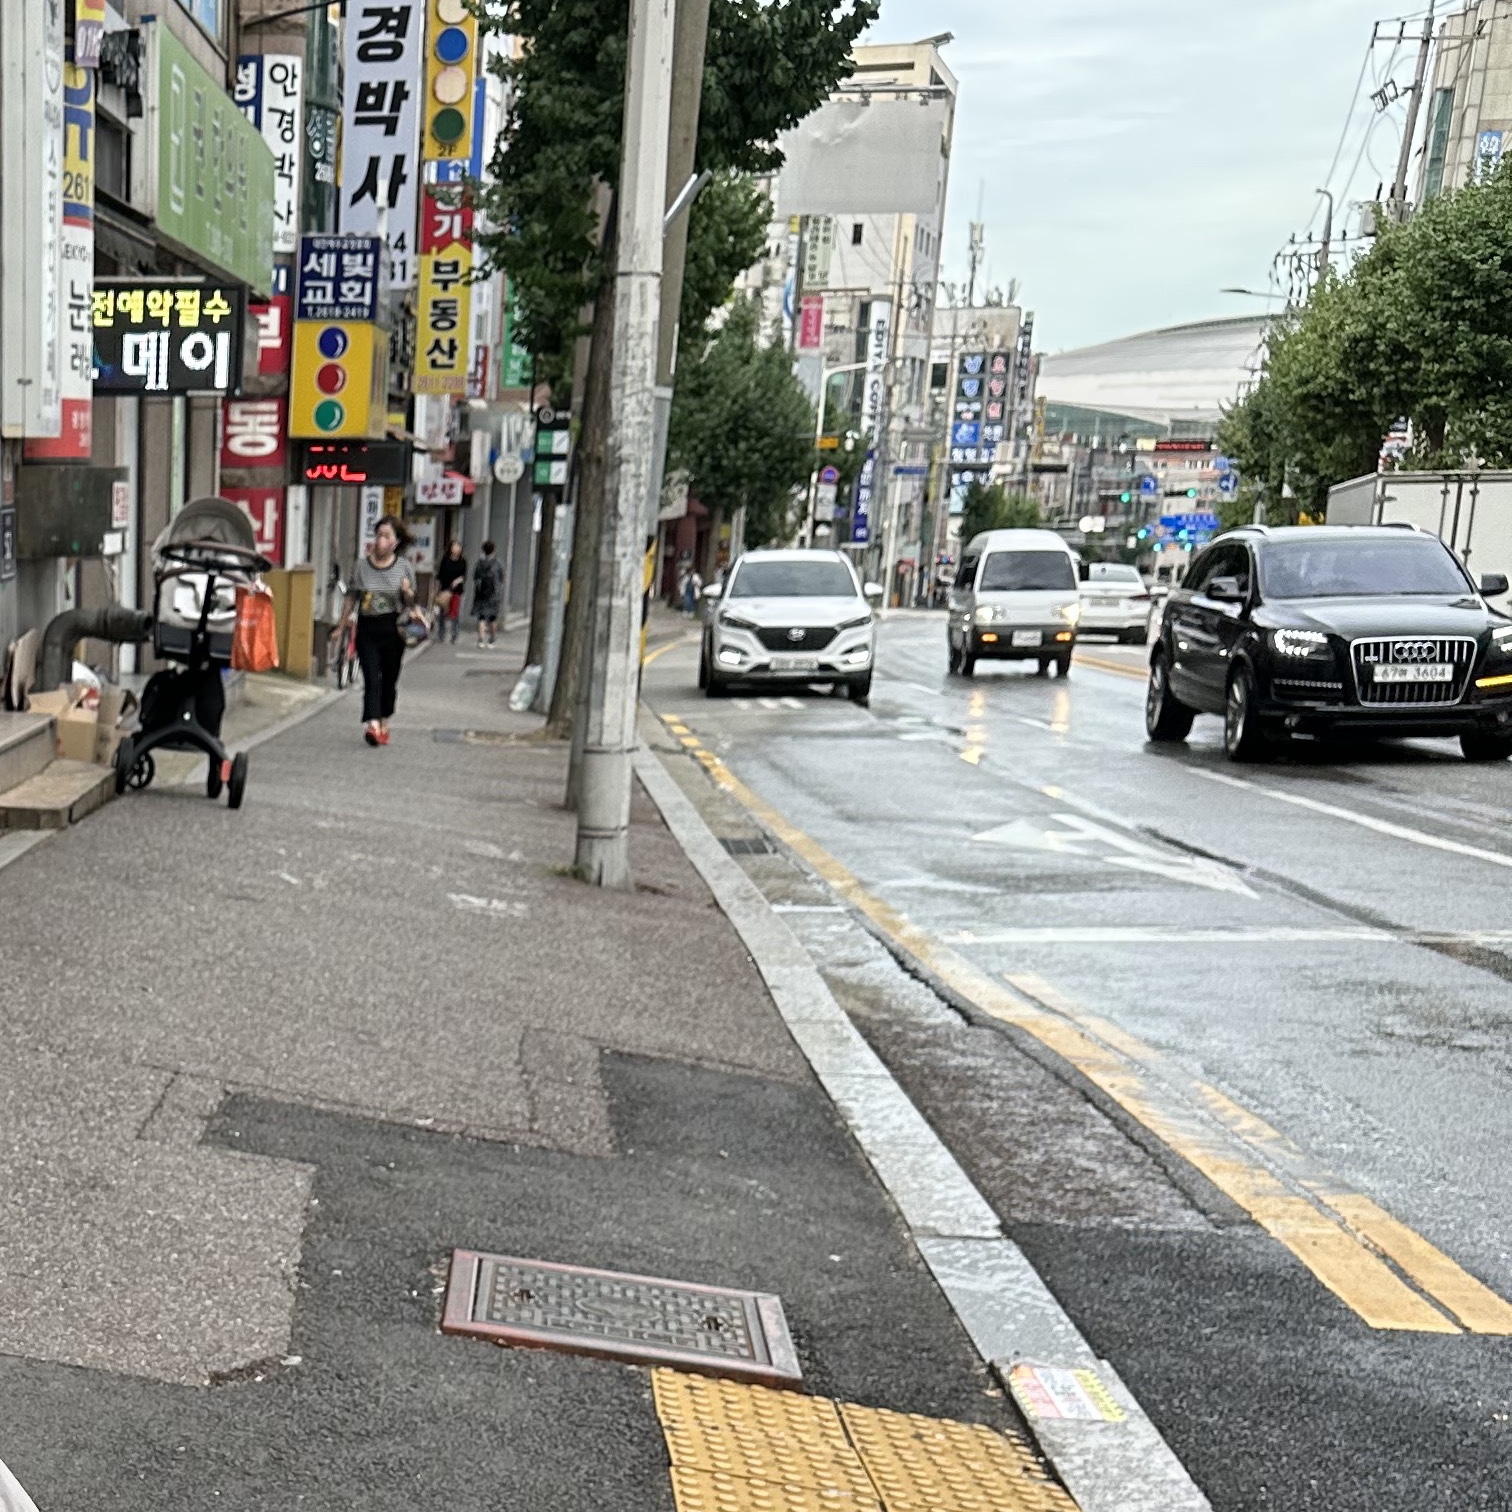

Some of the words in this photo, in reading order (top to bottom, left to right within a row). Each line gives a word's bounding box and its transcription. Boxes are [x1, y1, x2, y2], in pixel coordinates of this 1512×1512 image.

[268, 62, 299, 226] 안경박사
[303, 252, 374, 278] 세빛
[91, 289, 232, 327] 전예약필수
[301, 280, 372, 306] 교회
[426, 260, 461, 370] 부동산
